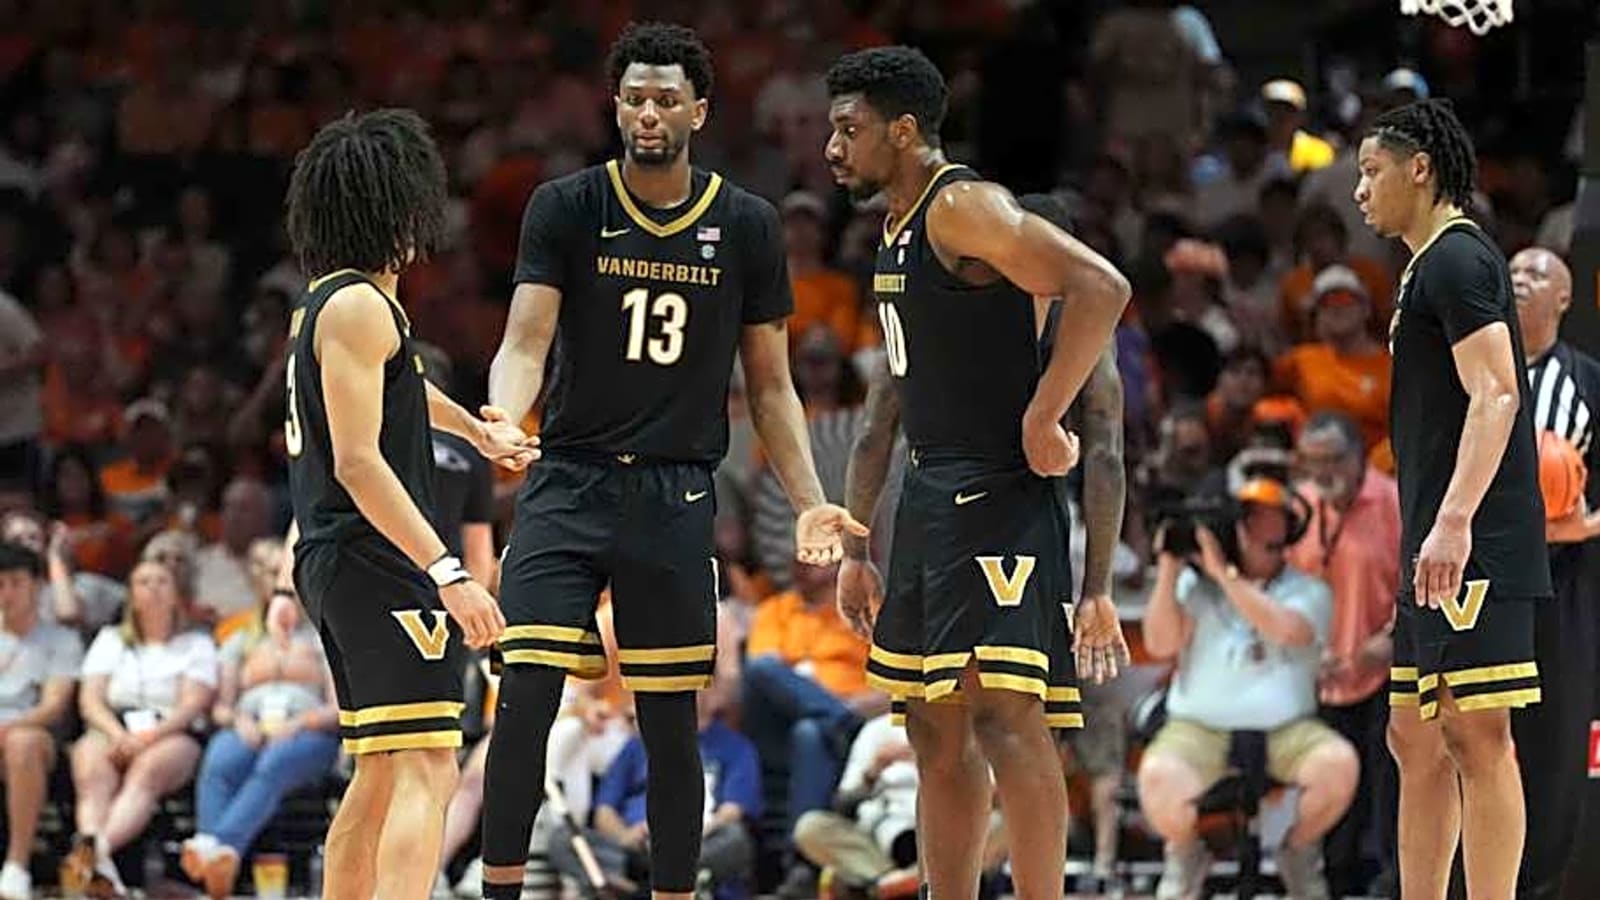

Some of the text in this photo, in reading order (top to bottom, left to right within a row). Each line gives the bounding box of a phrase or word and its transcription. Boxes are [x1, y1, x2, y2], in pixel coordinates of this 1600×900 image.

[597, 256, 721, 286] VANDERBILT
[622, 287, 688, 366] 13
[878, 301, 908, 377] 10
[974, 555, 1036, 607] V
[1439, 579, 1490, 631] V
[390, 609, 450, 660] V
